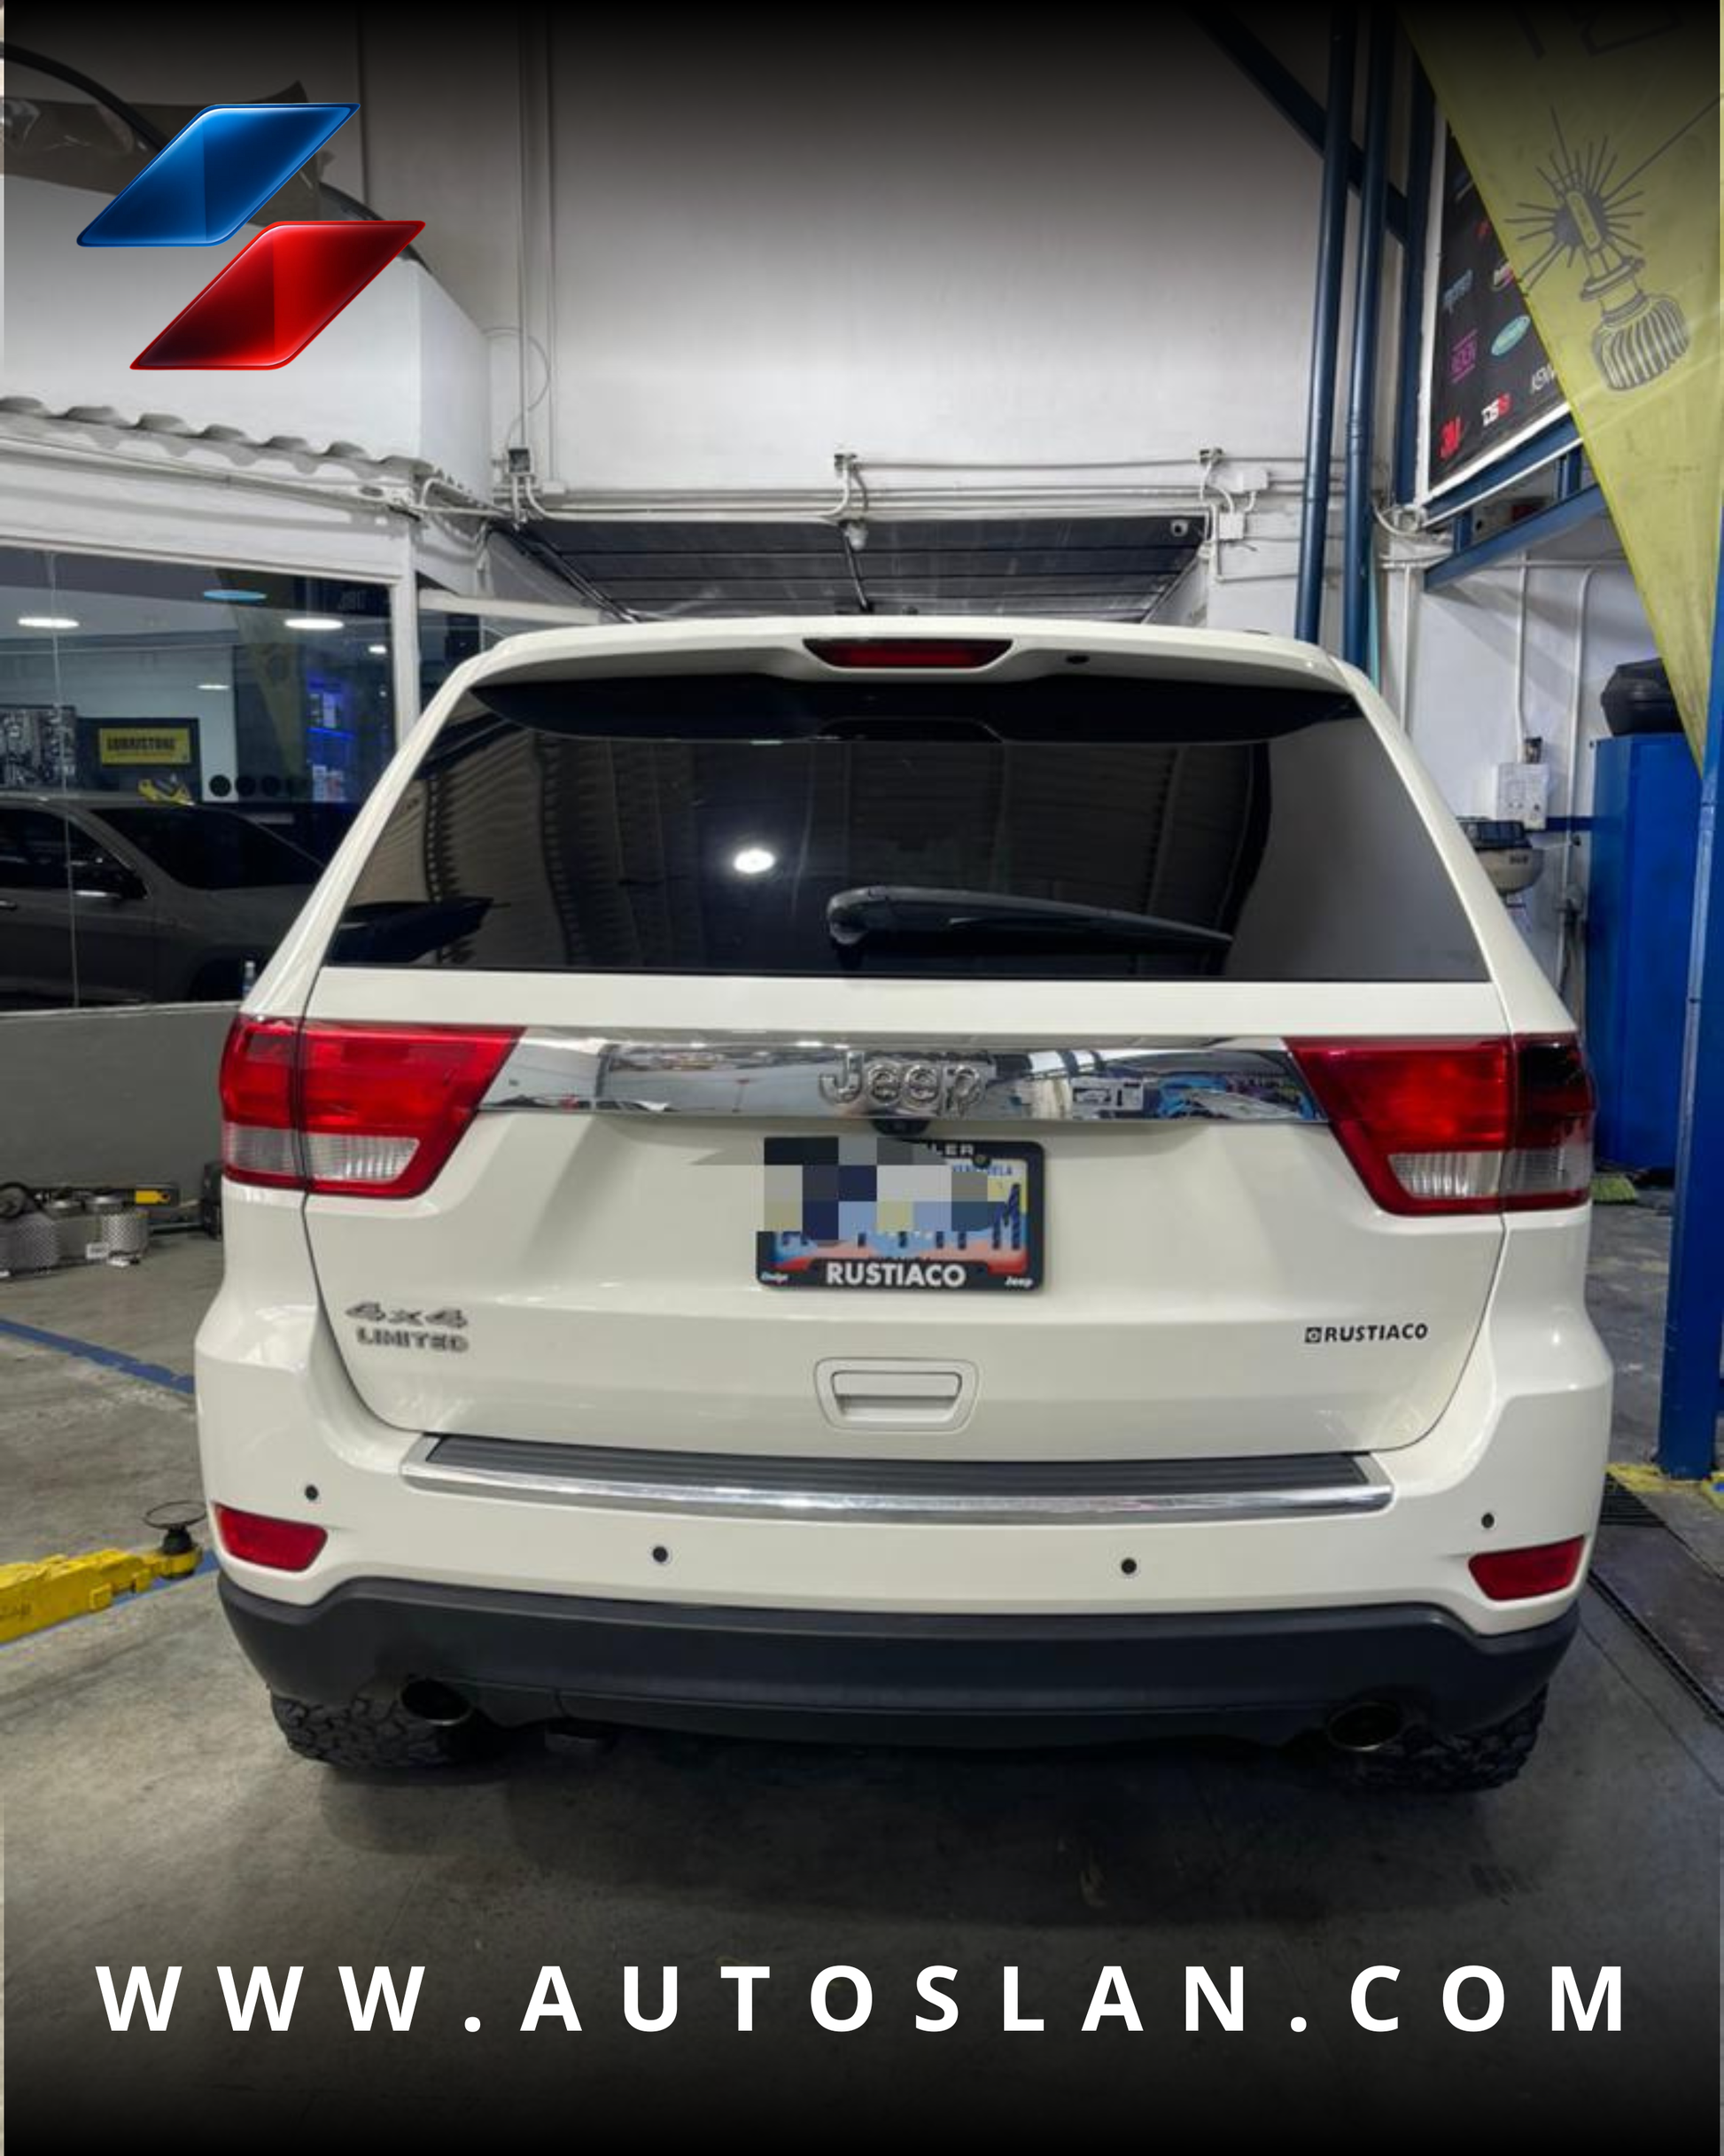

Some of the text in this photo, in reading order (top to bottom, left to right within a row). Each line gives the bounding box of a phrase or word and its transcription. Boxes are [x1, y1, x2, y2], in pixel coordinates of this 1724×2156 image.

[820, 1050, 985, 1117] Jeep
[826, 1262, 967, 1288] RUSTIACO
[357, 1327, 470, 1353] LIMITED
[1324, 1322, 1429, 1343] RUSTIACO
